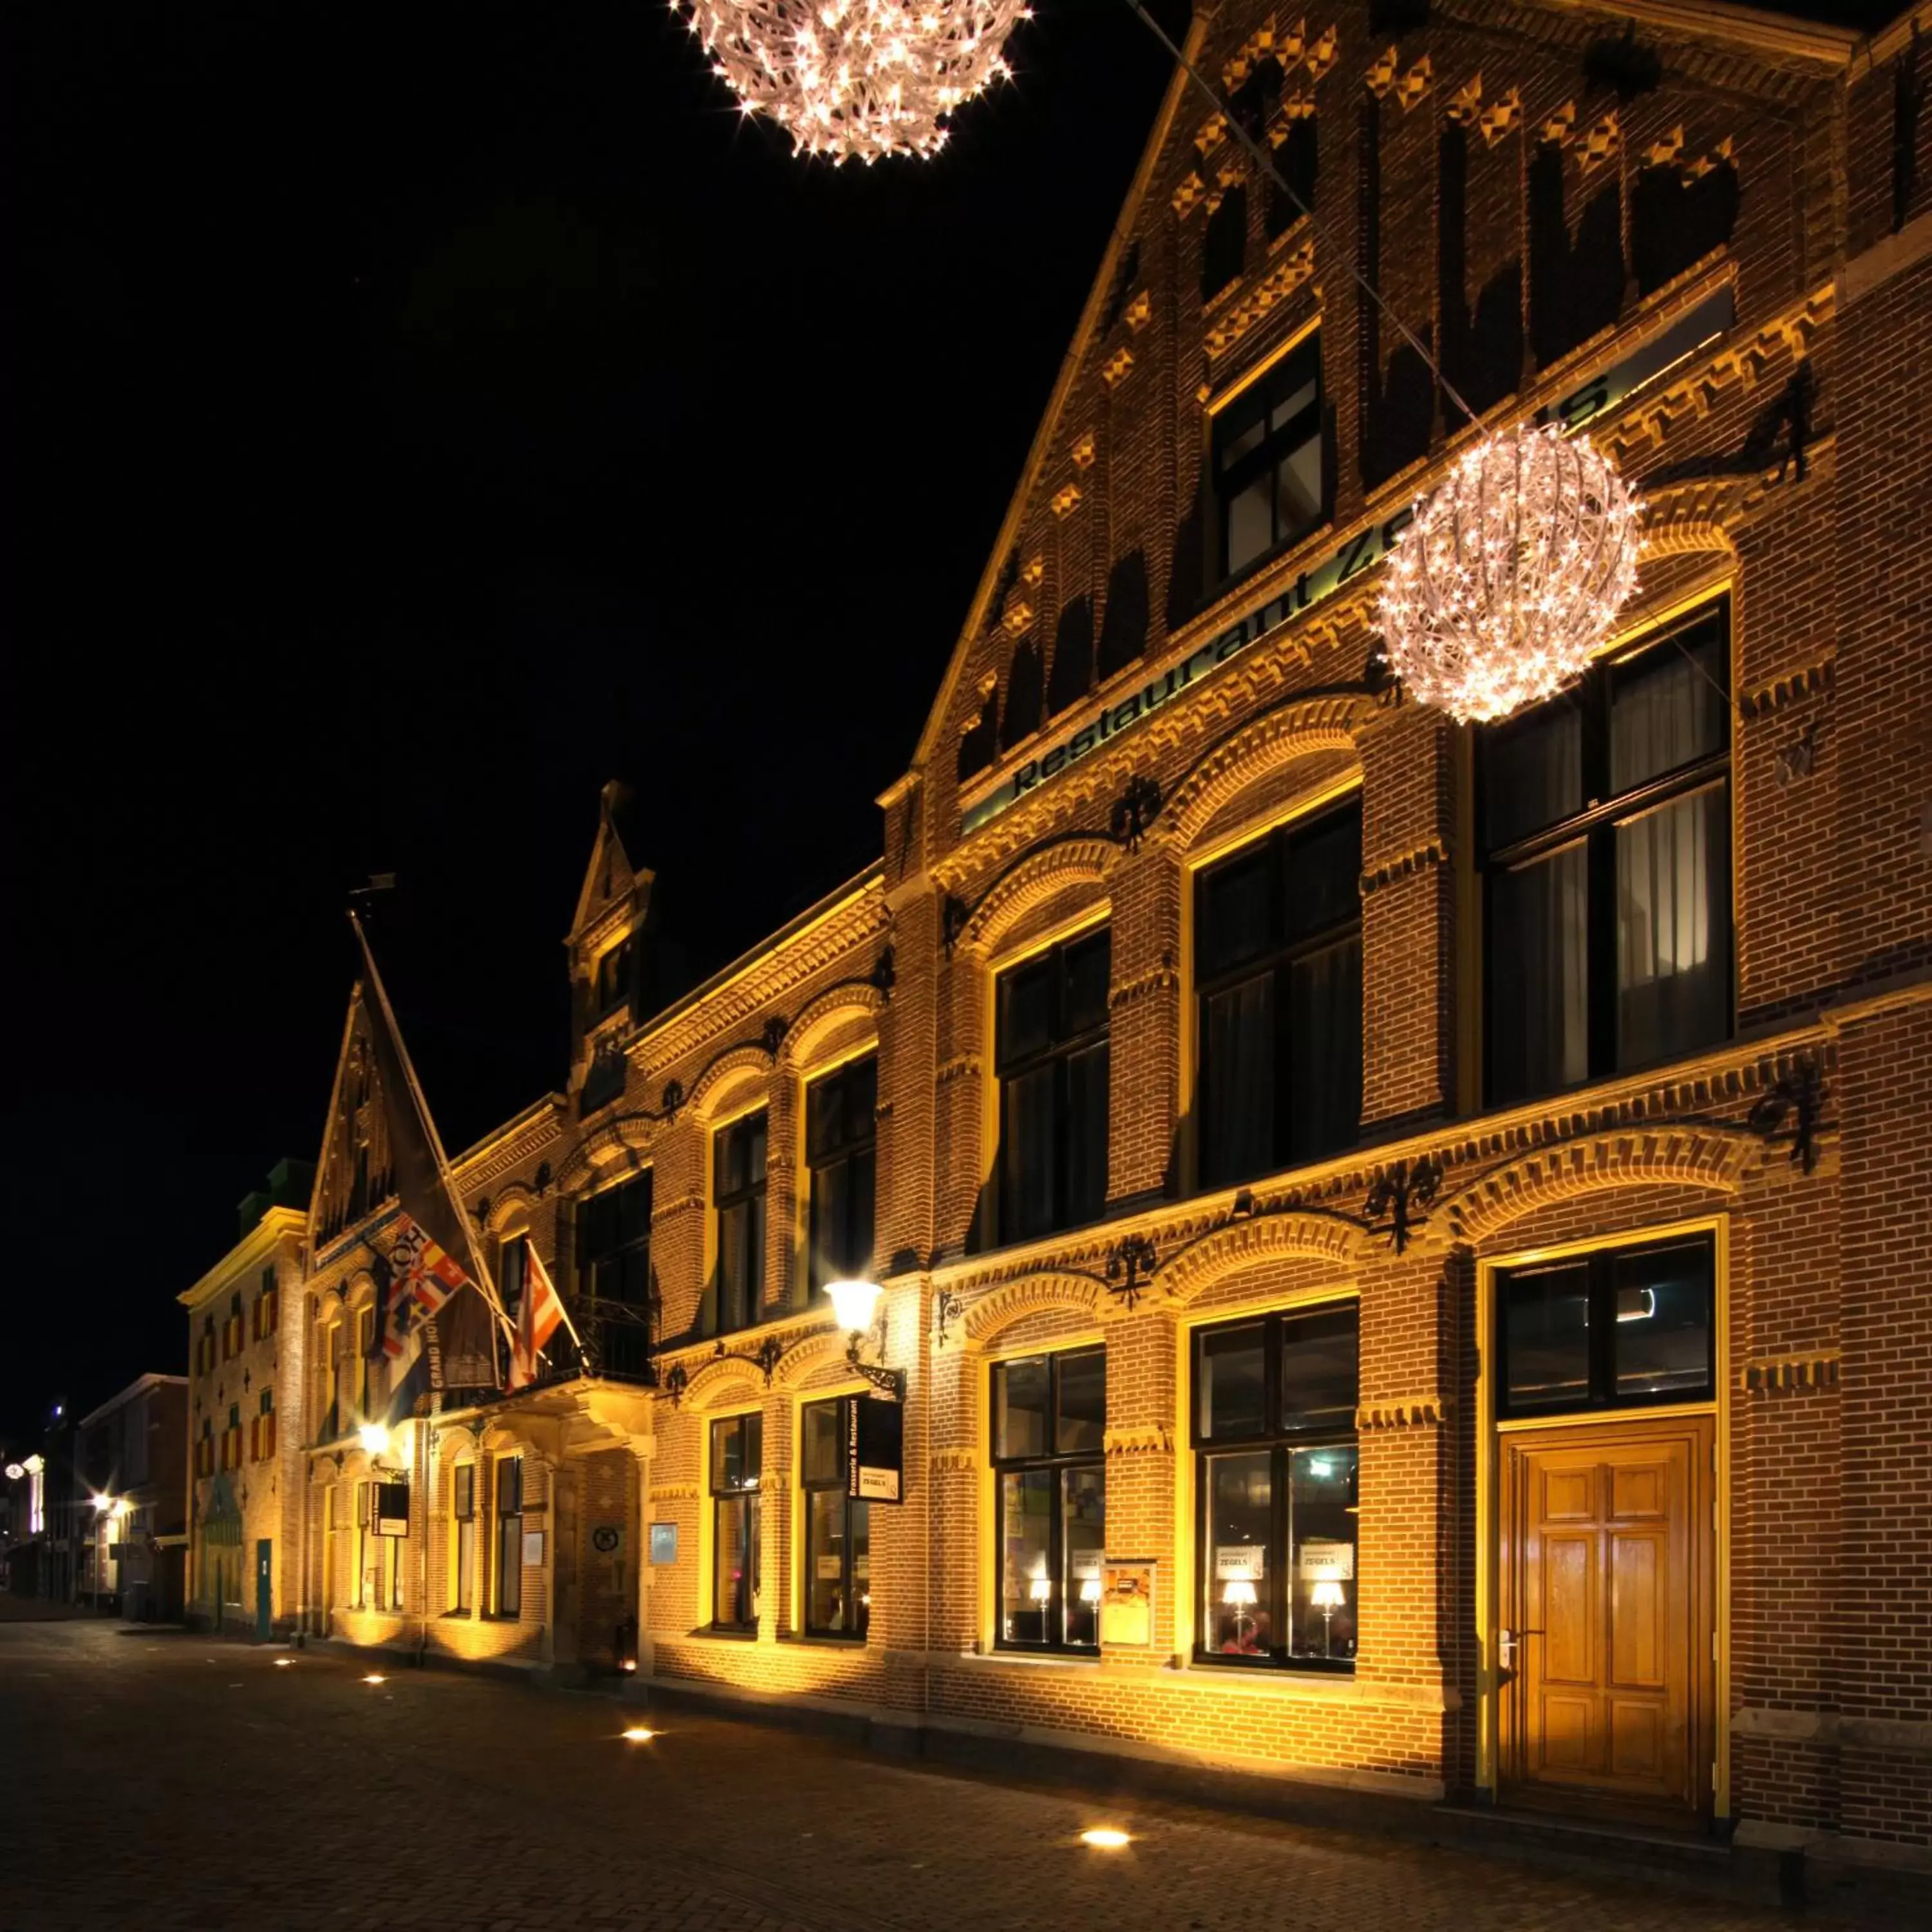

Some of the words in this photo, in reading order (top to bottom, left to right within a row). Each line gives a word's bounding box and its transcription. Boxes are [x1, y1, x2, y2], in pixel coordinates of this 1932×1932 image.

[1012, 571, 1312, 800] Restaurant
[428, 1347, 444, 1388] GRAND
[849, 1399, 858, 1446] Restaurant
